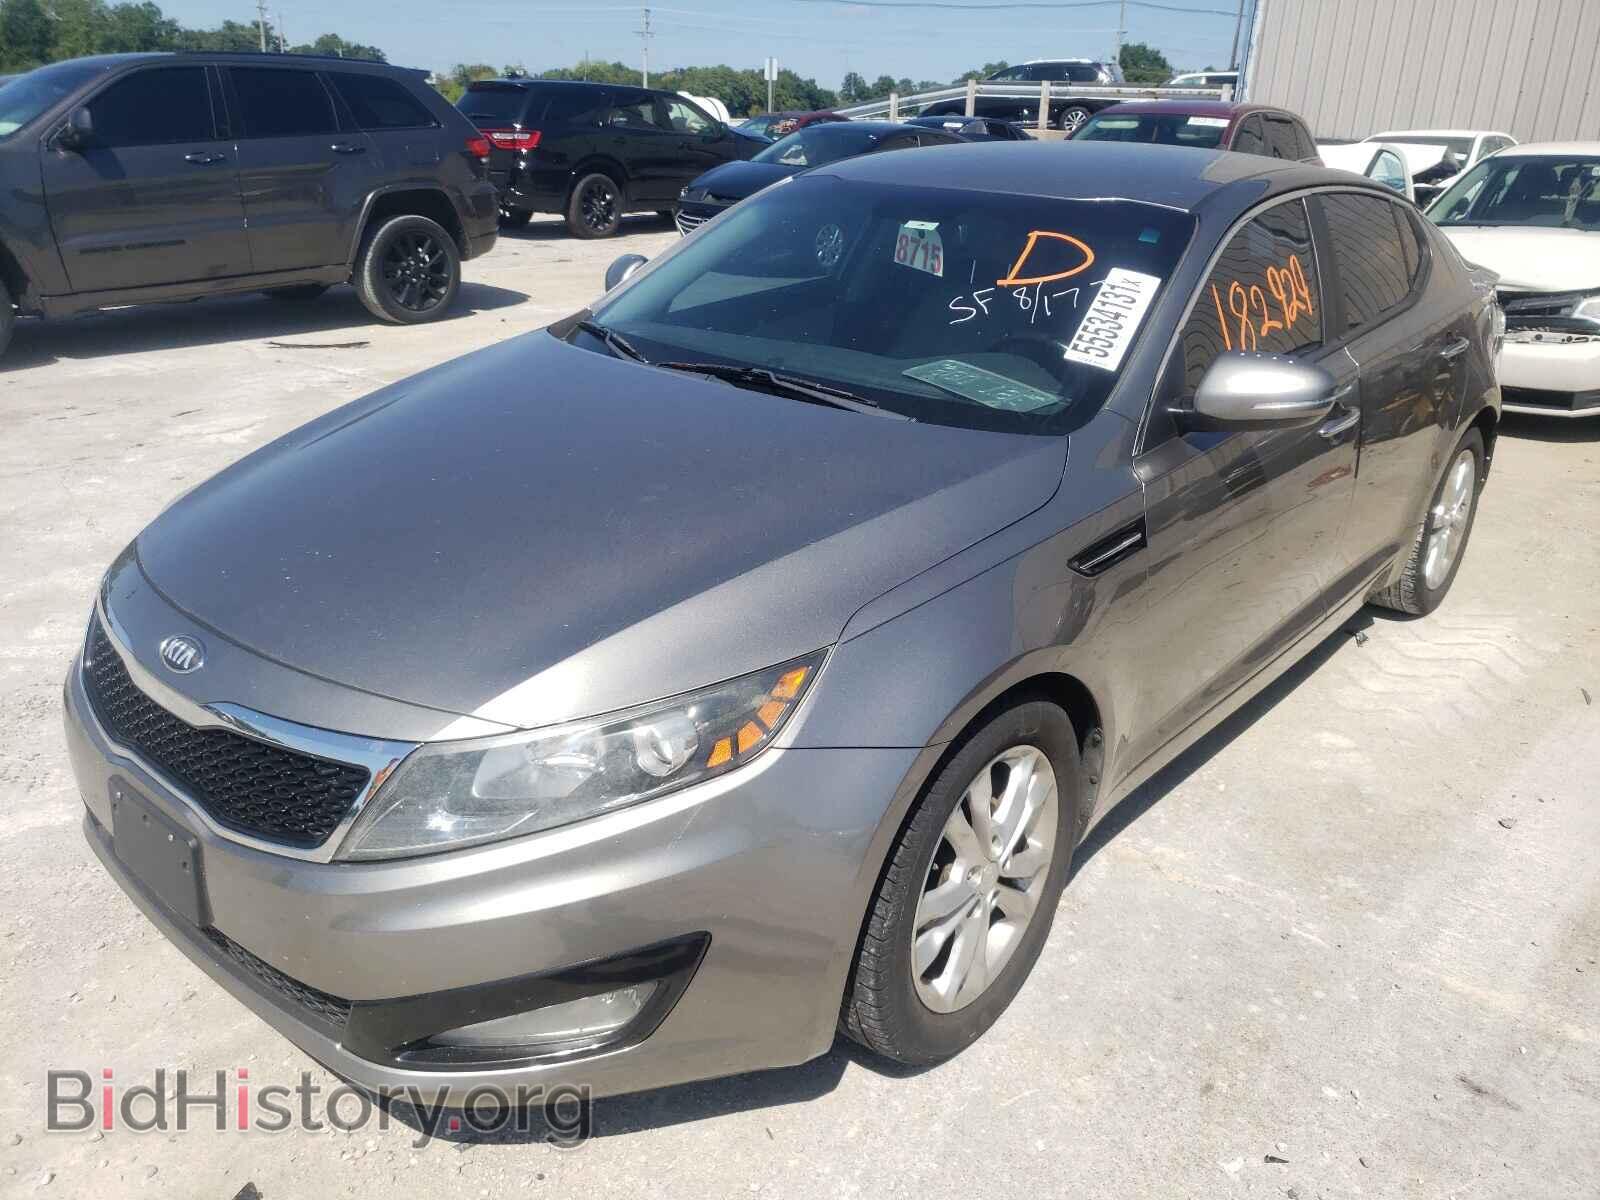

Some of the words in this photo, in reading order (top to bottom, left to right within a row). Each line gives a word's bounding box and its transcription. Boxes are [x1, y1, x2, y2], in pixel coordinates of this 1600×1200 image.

[896, 233, 942, 273] 8715
[997, 231, 1094, 286] D
[949, 287, 995, 325] SF
[164, 638, 197, 669] KIA
